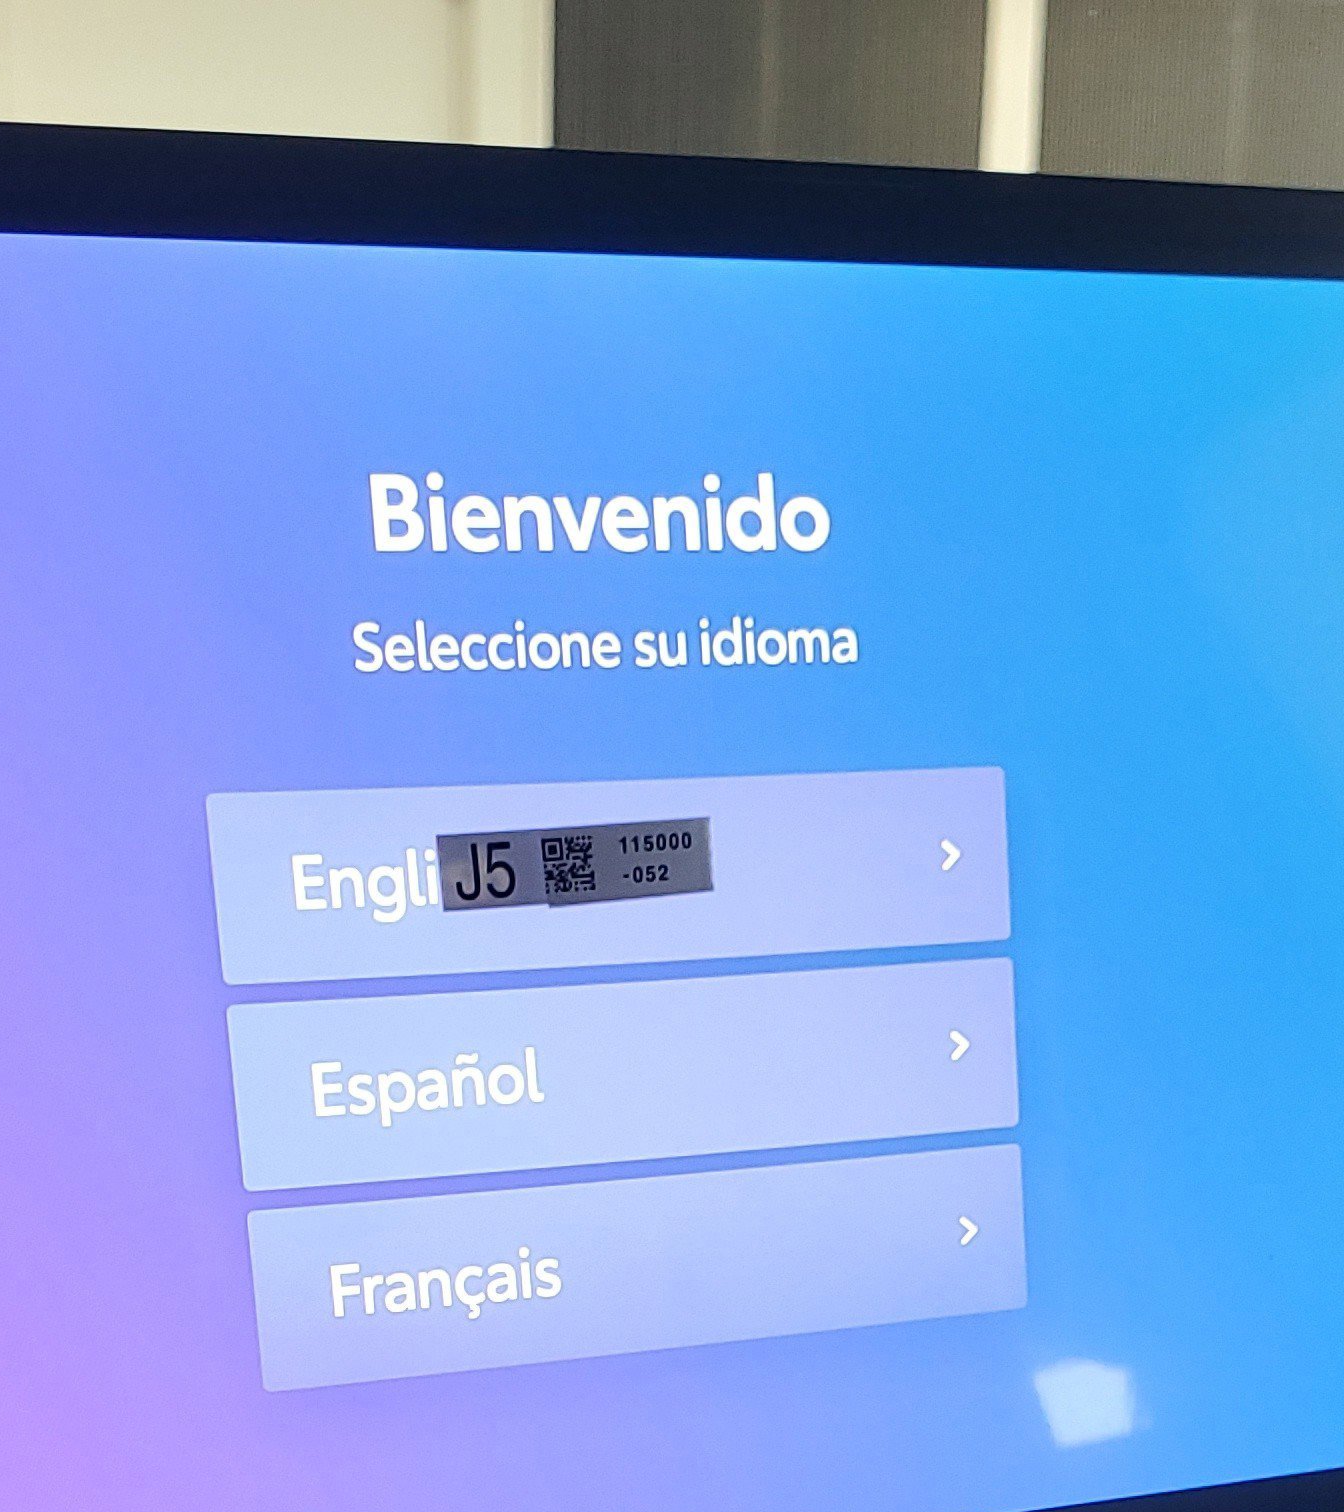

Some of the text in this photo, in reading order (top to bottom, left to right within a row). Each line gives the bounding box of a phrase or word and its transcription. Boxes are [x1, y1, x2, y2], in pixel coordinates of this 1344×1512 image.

[367, 470, 830, 554] Bienvenido
[351, 617, 859, 674] Seleccione su idioma
[455, 841, 516, 901] J5
[618, 832, 692, 854] 115000
[622, 864, 670, 884] -052
[290, 848, 440, 922] Engli
[310, 1047, 545, 1127] Español
[328, 1248, 563, 1320] Français
